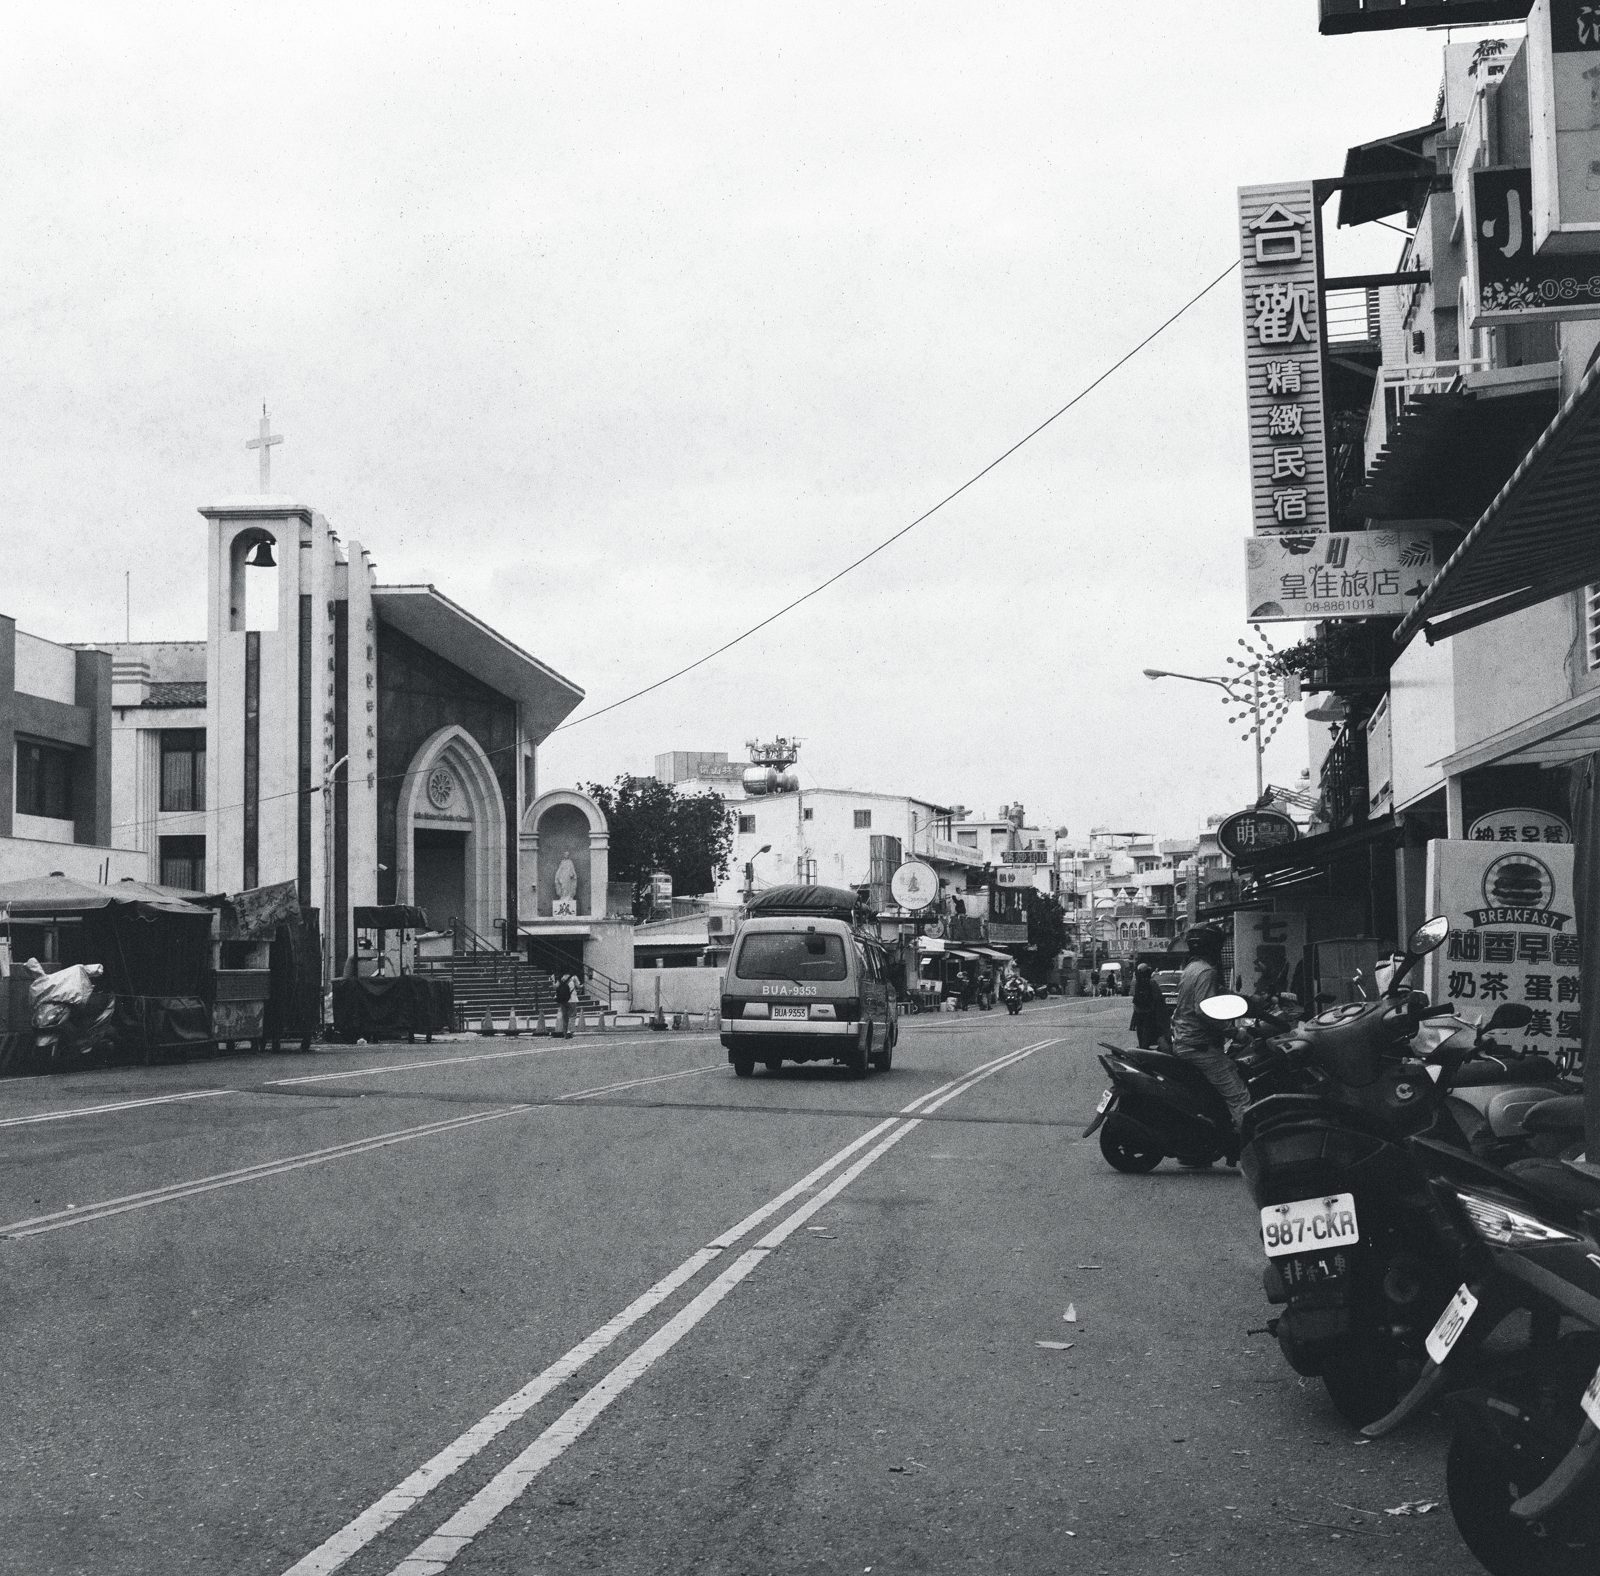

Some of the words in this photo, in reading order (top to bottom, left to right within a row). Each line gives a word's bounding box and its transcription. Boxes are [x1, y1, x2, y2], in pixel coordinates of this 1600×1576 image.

[1249, 202, 1311, 343] 合歡
[1266, 360, 1309, 521] 精緻民宿
[1280, 564, 1400, 600] 皇佳旅店
[1479, 909, 1559, 928] BREAKFAST
[1447, 929, 1581, 966] 柚香早餐
[762, 985, 817, 996] BUA-9353
[1447, 970, 1509, 1001] 奶茶
[774, 1008, 806, 1018] BUA-9353
